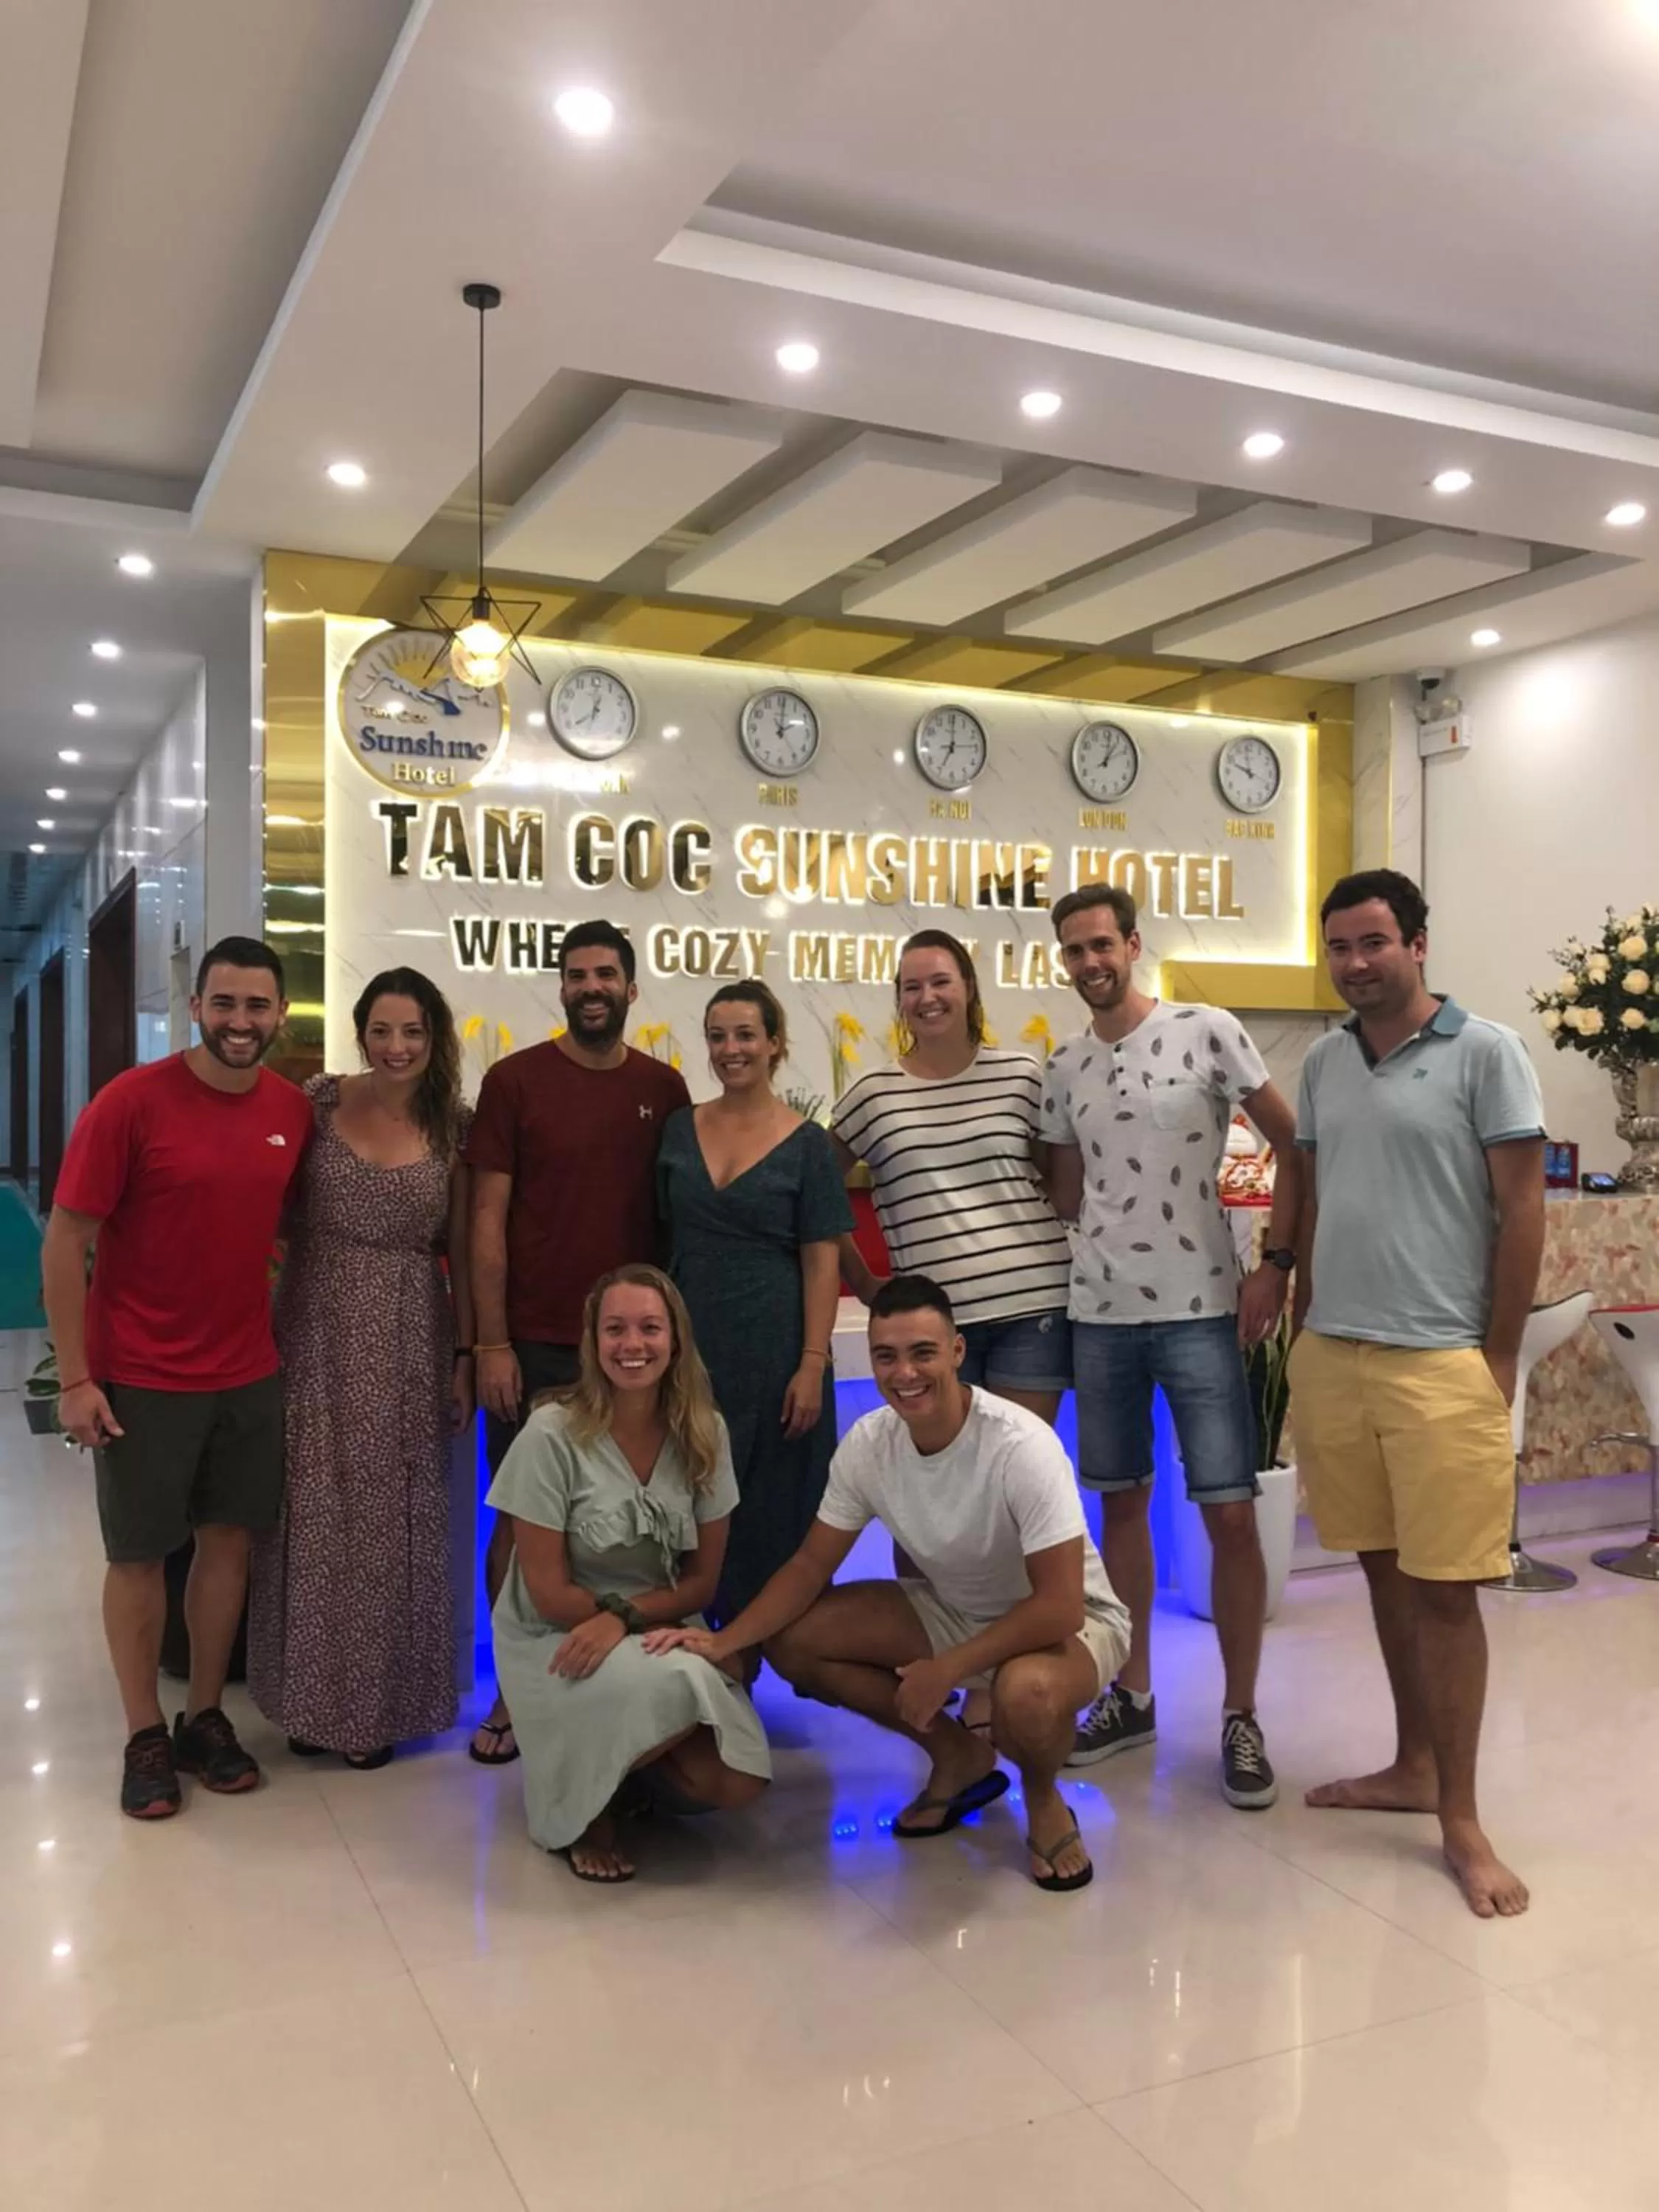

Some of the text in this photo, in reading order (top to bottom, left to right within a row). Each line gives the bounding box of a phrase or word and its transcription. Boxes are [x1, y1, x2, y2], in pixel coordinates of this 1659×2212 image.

[392, 762, 455, 786] Hotel
[378, 801, 1245, 919] TAM COC SUNSHINE HOTEL
[451, 917, 630, 973] WHE
[650, 925, 771, 978] COZY
